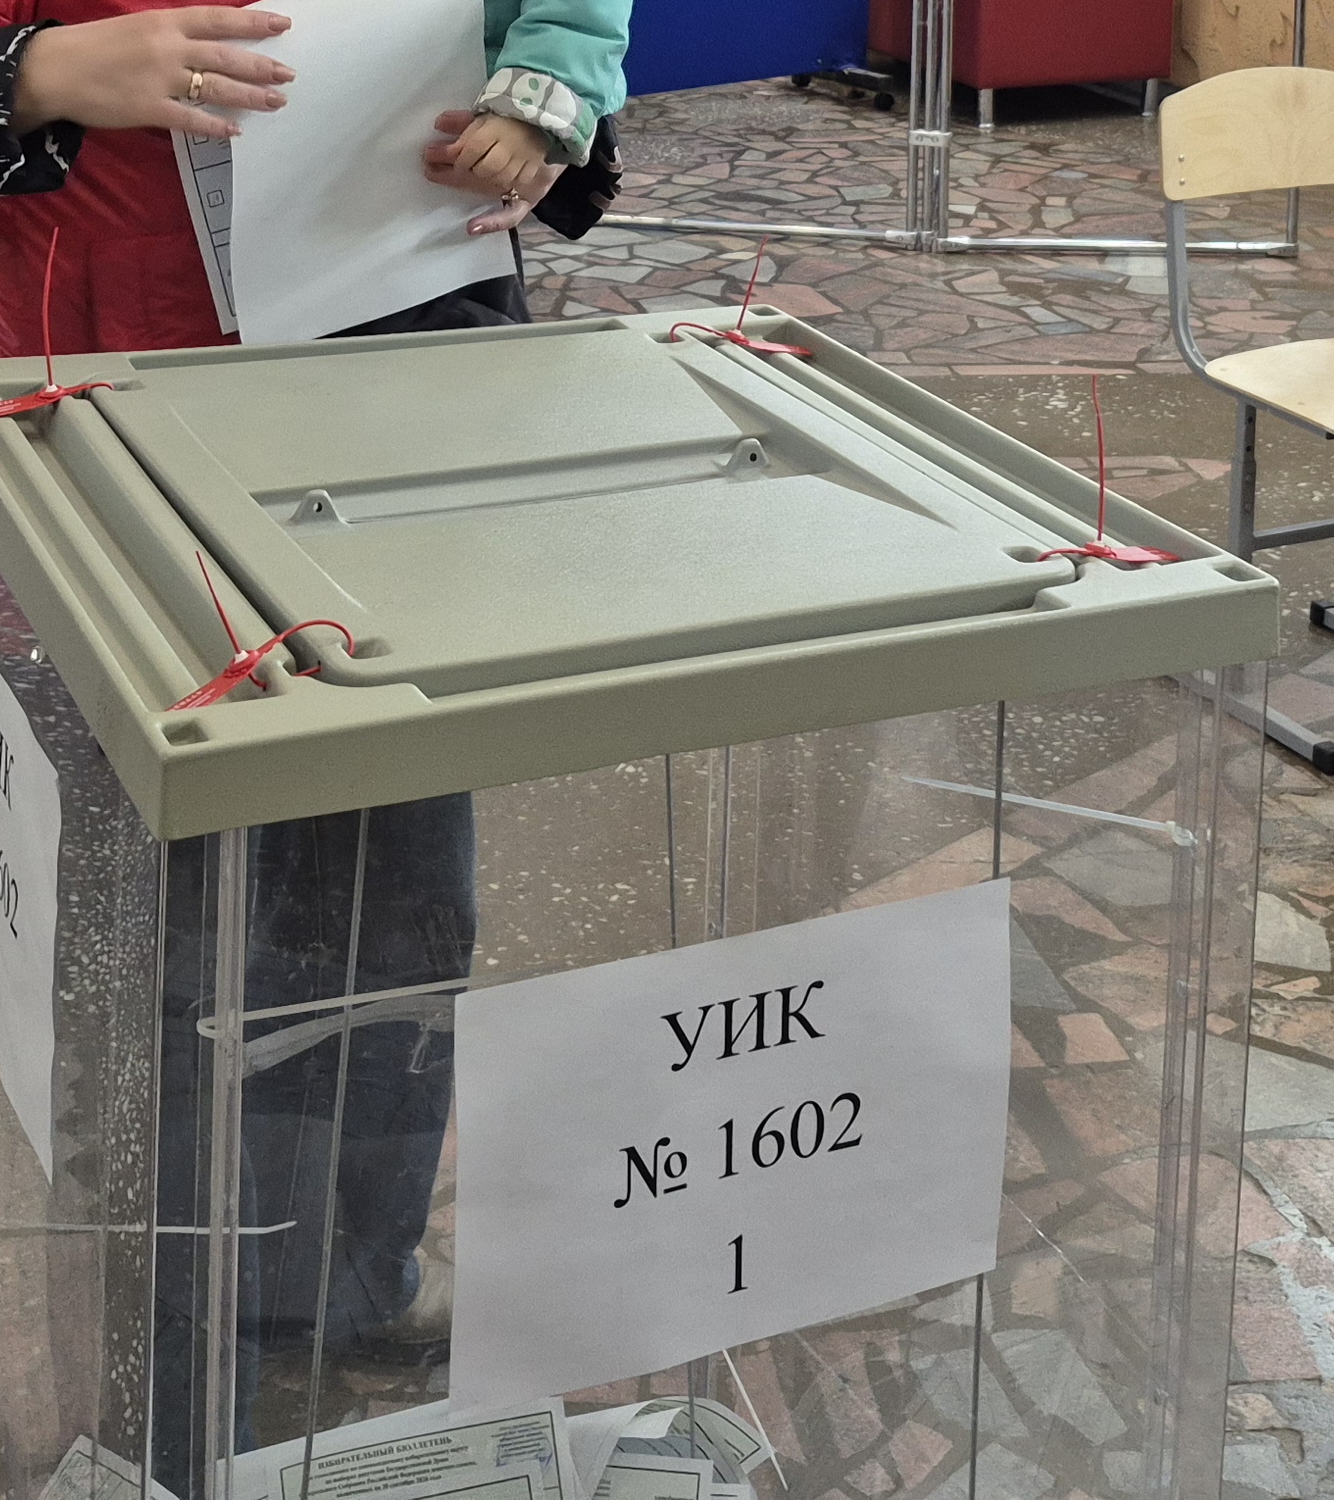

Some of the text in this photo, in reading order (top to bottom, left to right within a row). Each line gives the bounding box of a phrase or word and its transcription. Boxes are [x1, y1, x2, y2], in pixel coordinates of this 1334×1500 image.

[662, 981, 825, 1071] УИК
[614, 1093, 863, 1208] № 1602
[728, 1235, 749, 1293] 1
